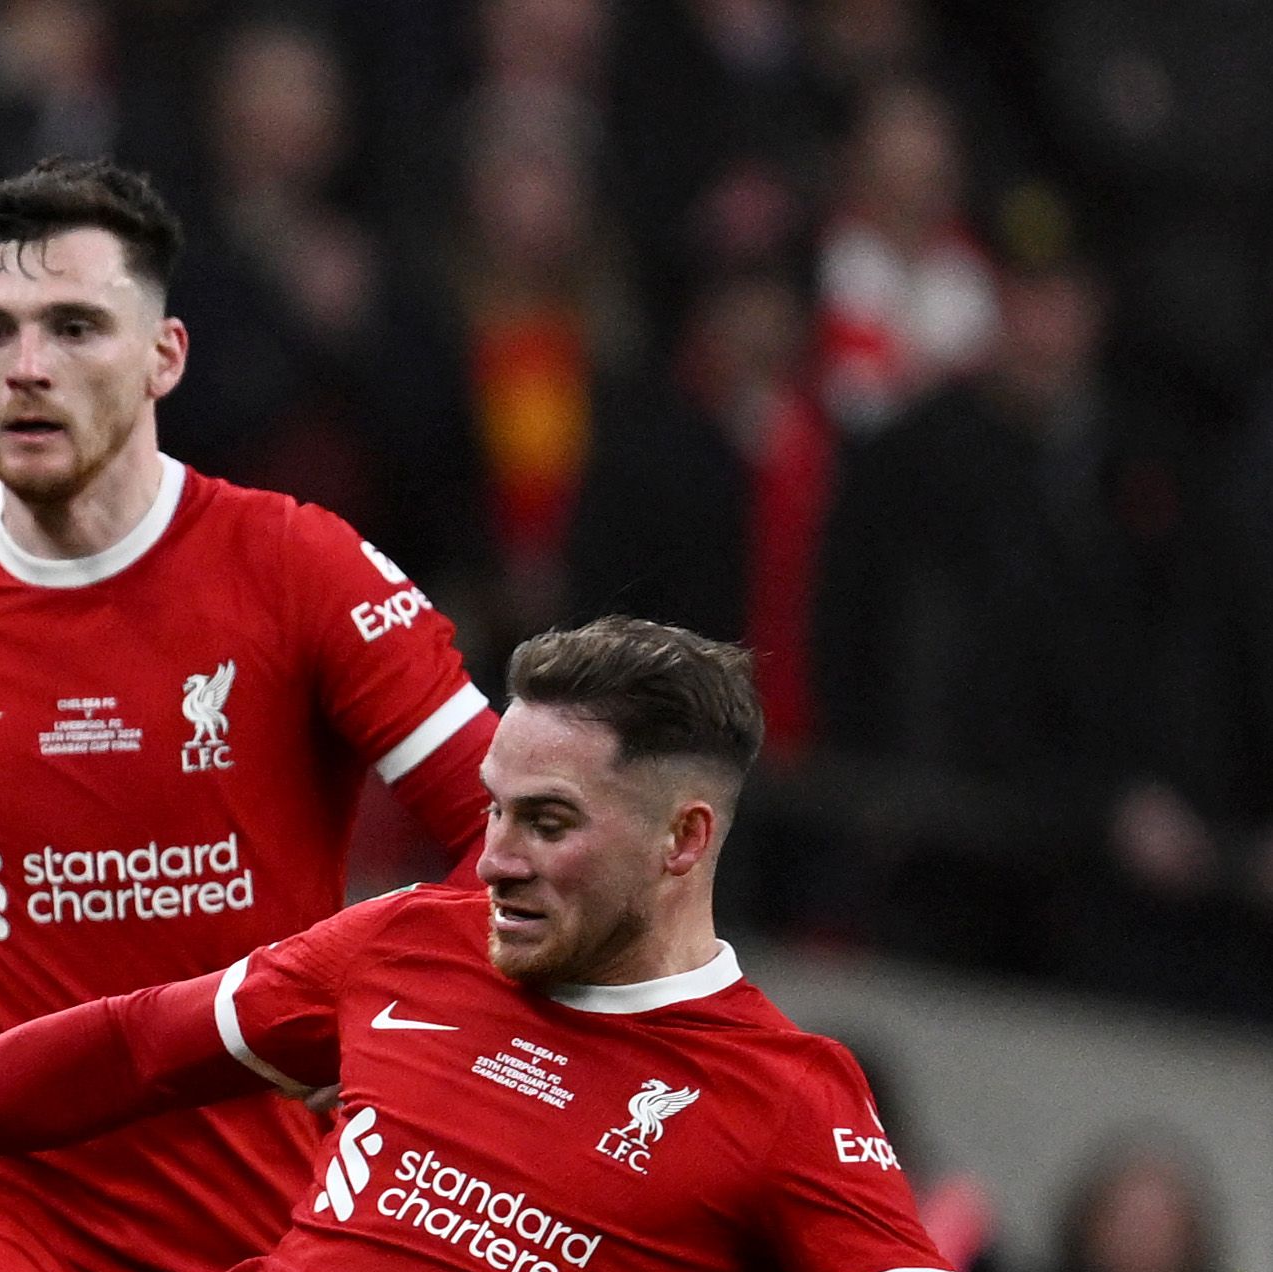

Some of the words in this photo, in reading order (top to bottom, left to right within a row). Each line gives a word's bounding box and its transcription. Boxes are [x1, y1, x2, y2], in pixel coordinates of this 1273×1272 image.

[23, 832, 239, 886] standard
[27, 868, 254, 924] chartered
[495, 1052, 547, 1079] LIVERPOOL
[547, 1073, 562, 1085] FC
[511, 1037, 554, 1060] CHELSEA
[553, 1054, 568, 1066] FC
[471, 1065, 518, 1089] CARABAO
[517, 1083, 539, 1097] CUP
[537, 1091, 566, 1110] FINAL
[475, 1055, 503, 1072] 25TH
[500, 1066, 551, 1091] FEBRUARY
[549, 1085, 575, 1102] 2024
[394, 1150, 602, 1269] standard
